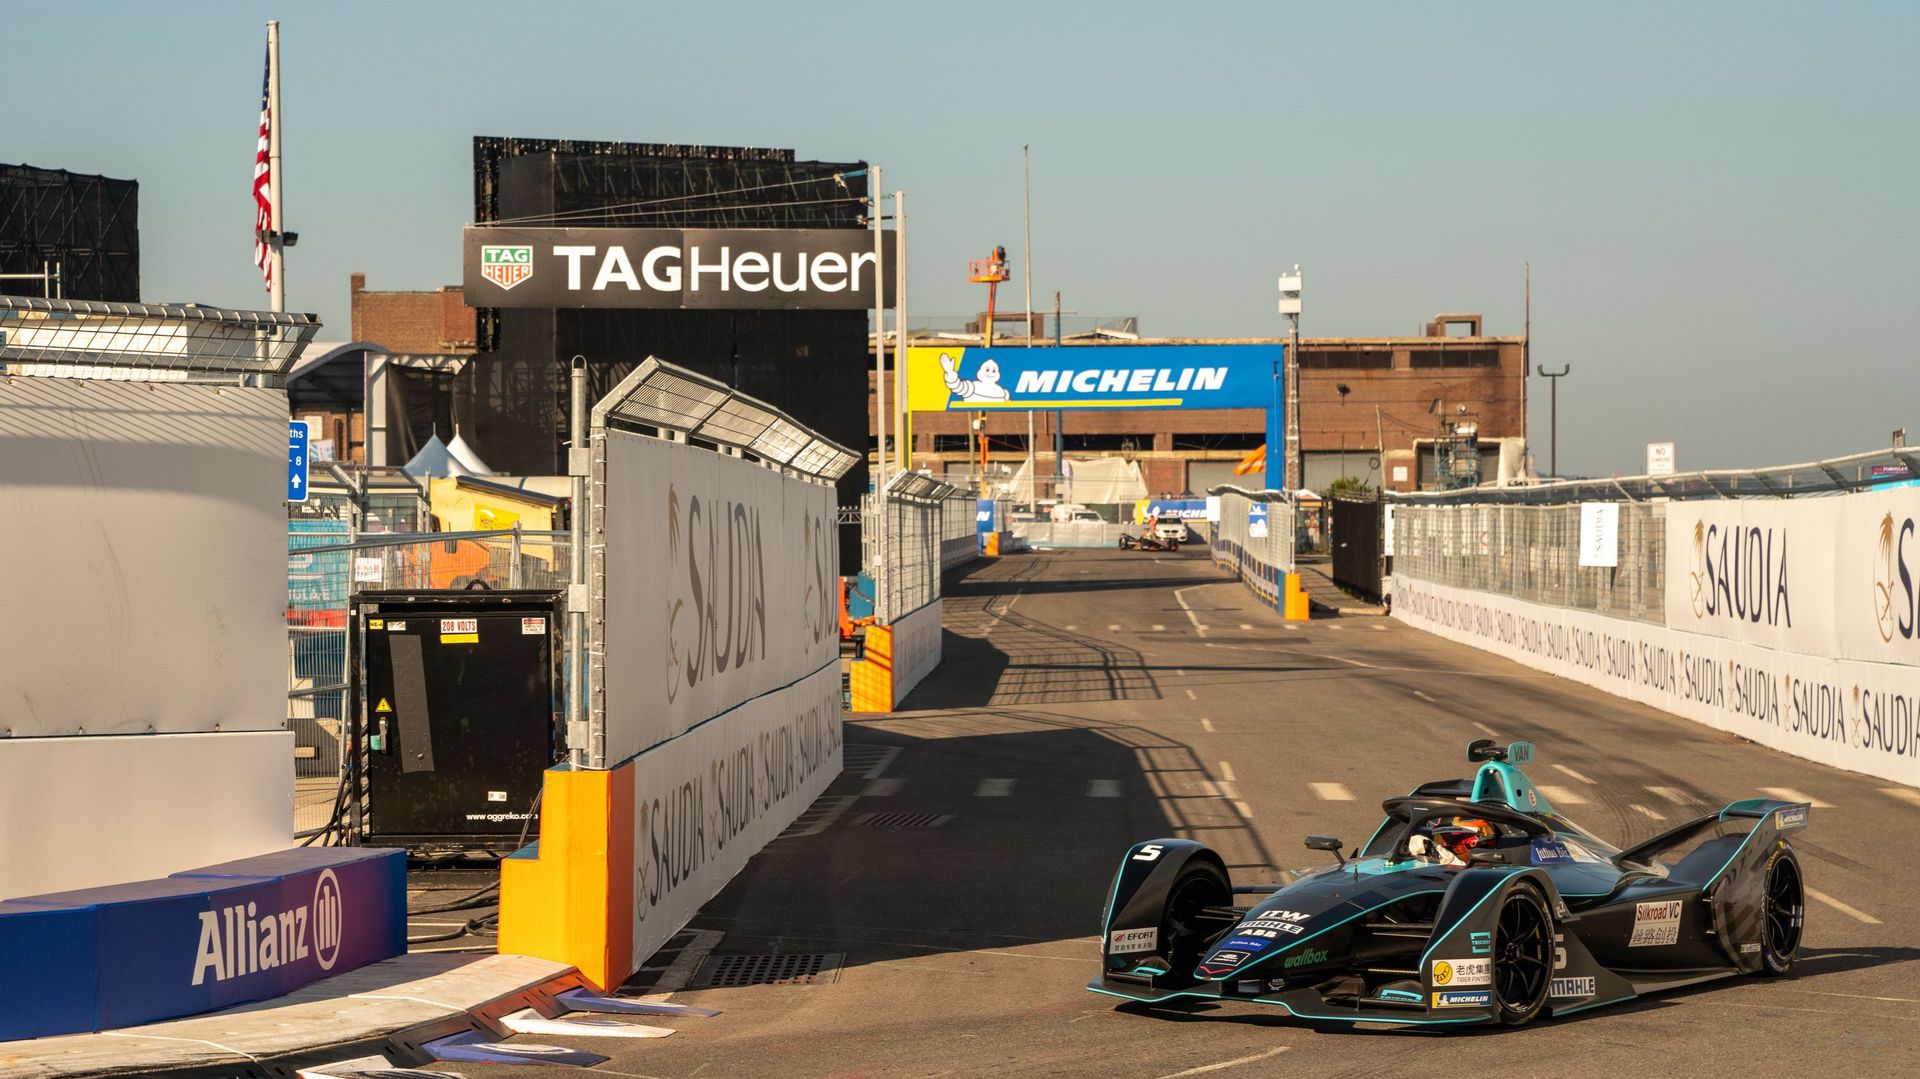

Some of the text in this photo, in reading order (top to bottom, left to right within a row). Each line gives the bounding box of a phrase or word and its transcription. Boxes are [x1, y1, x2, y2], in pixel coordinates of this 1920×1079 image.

[486, 249, 528, 263] TAG
[485, 265, 529, 285] HEUER
[1015, 367, 1228, 393] MICHELIN
[1706, 523, 1791, 628] SAUDIA
[687, 494, 766, 688] SAUDIA
[442, 621, 476, 631] 208 VOLTS
[1497, 608, 1517, 646] SAUDIA
[1521, 615, 1542, 657] SAUDIA
[1547, 623, 1570, 663] SAUDIA
[1576, 628, 1601, 672] SAUDIA
[1607, 636, 1636, 683] SAUDIA
[1643, 643, 1676, 695] SAUDIA
[1685, 654, 1725, 709] SAUDIA
[1735, 664, 1779, 726] SAUDIA
[1792, 678, 1846, 744] SAUDIA
[1513, 745, 1530, 762] VAN
[650, 773, 705, 907] SAUDIA
[718, 739, 755, 850] SAUDIA
[764, 722, 794, 811] SAUDIA
[1132, 844, 1165, 861] 5
[1257, 910, 1311, 922] ITW
[1636, 901, 1680, 921] Silkroad VC
[1127, 931, 1154, 941] EFORT
[1236, 921, 1304, 935] MAHLE
[1238, 929, 1277, 938] ABB
[191, 901, 309, 986] Allianz
[1284, 948, 1329, 969] wallbox
[1551, 978, 1594, 995] MAHLE
[1449, 995, 1489, 1003] MICHELIN
